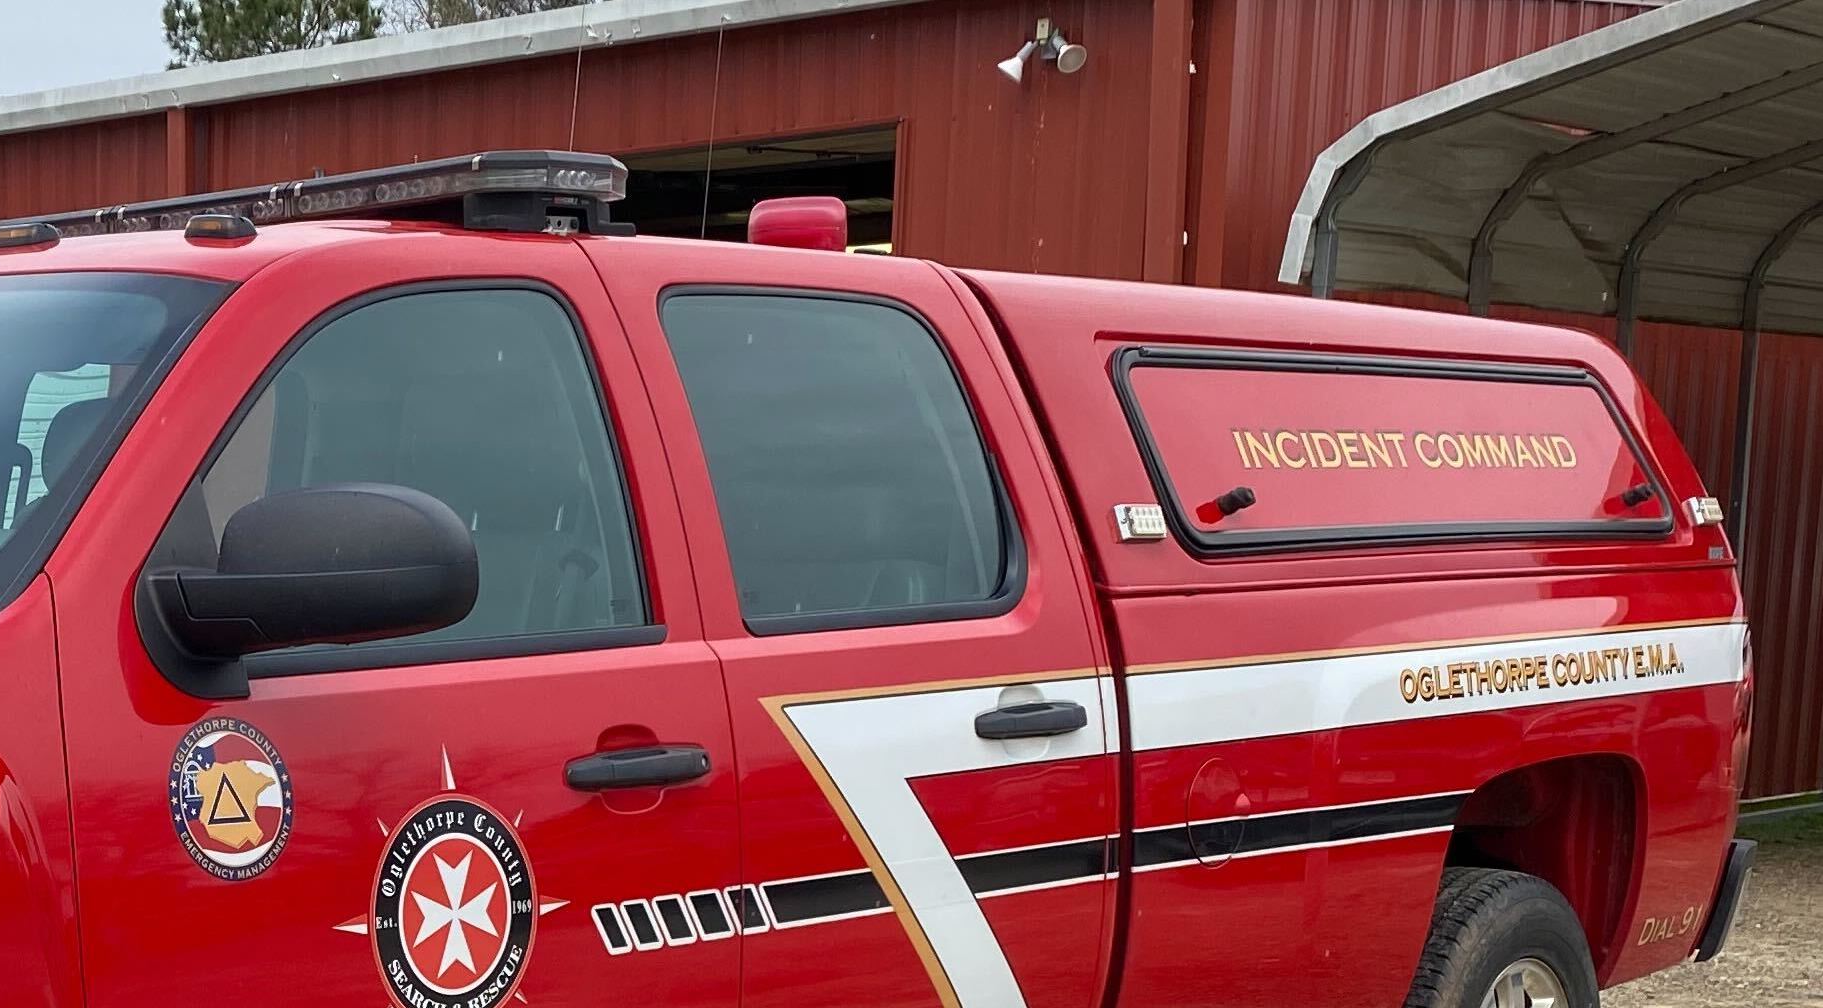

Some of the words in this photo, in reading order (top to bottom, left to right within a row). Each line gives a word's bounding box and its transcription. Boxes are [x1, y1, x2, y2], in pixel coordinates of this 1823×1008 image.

[1232, 430, 1409, 468] INCIDENT
[1414, 433, 1577, 468] COMMAND
[1400, 655, 1551, 704] OGLETHORPE
[1552, 648, 1629, 686] COUNTY
[1632, 643, 1685, 678] E.M.A.
[172, 719, 236, 772] OGLETHORPE
[239, 723, 283, 765] COUNTY
[180, 831, 235, 880] EMERGENCY
[236, 824, 291, 880] MANAGEMENT
[381, 811, 465, 897] Oglethorpe
[473, 812, 523, 888] County
[375, 916, 398, 930] Est.
[512, 900, 532, 915] 1969
[1637, 916, 1676, 946] DIAL
